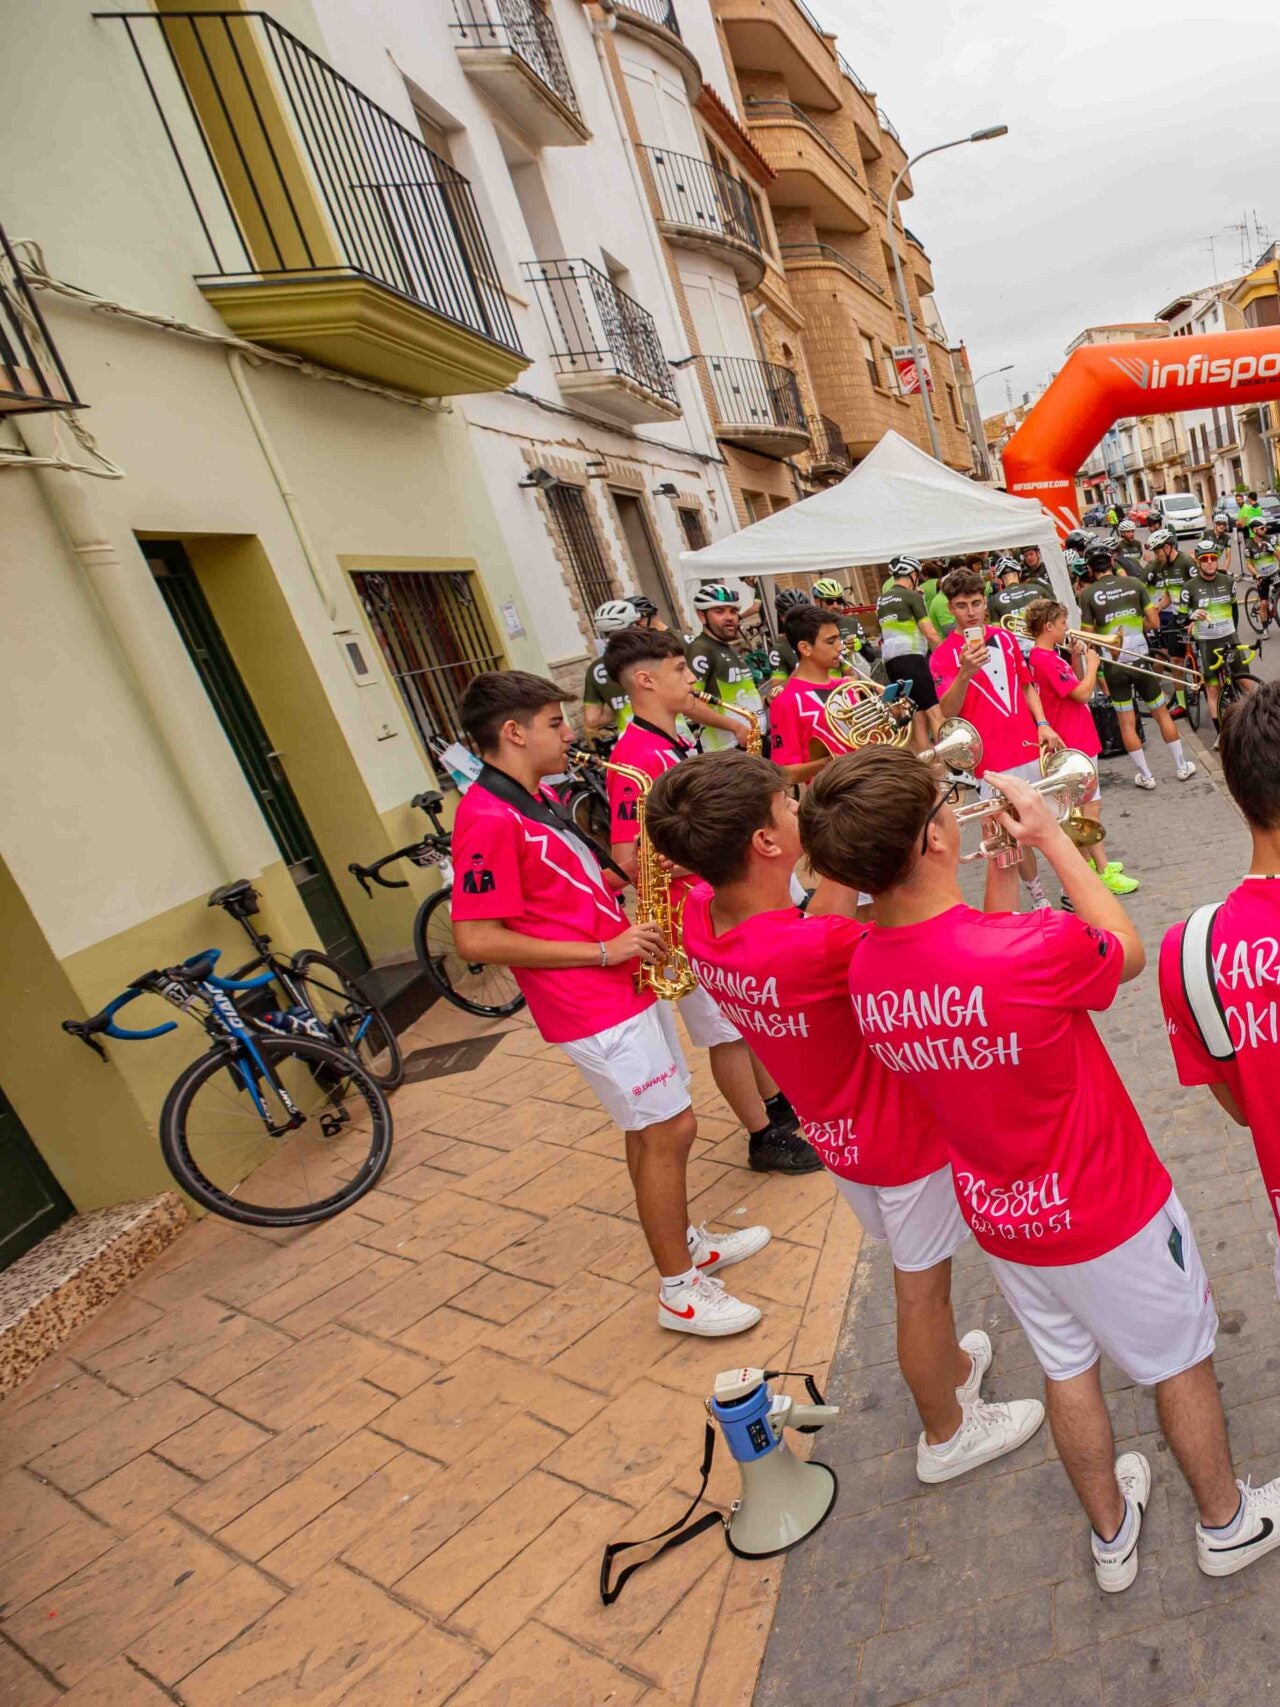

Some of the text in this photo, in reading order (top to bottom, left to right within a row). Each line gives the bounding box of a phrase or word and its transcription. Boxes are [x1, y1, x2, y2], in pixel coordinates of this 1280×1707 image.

[691, 957, 780, 1009] ARANGA
[851, 983, 989, 1036] XARANGA
[971, 1209, 1072, 1240] 623 12 70 57
